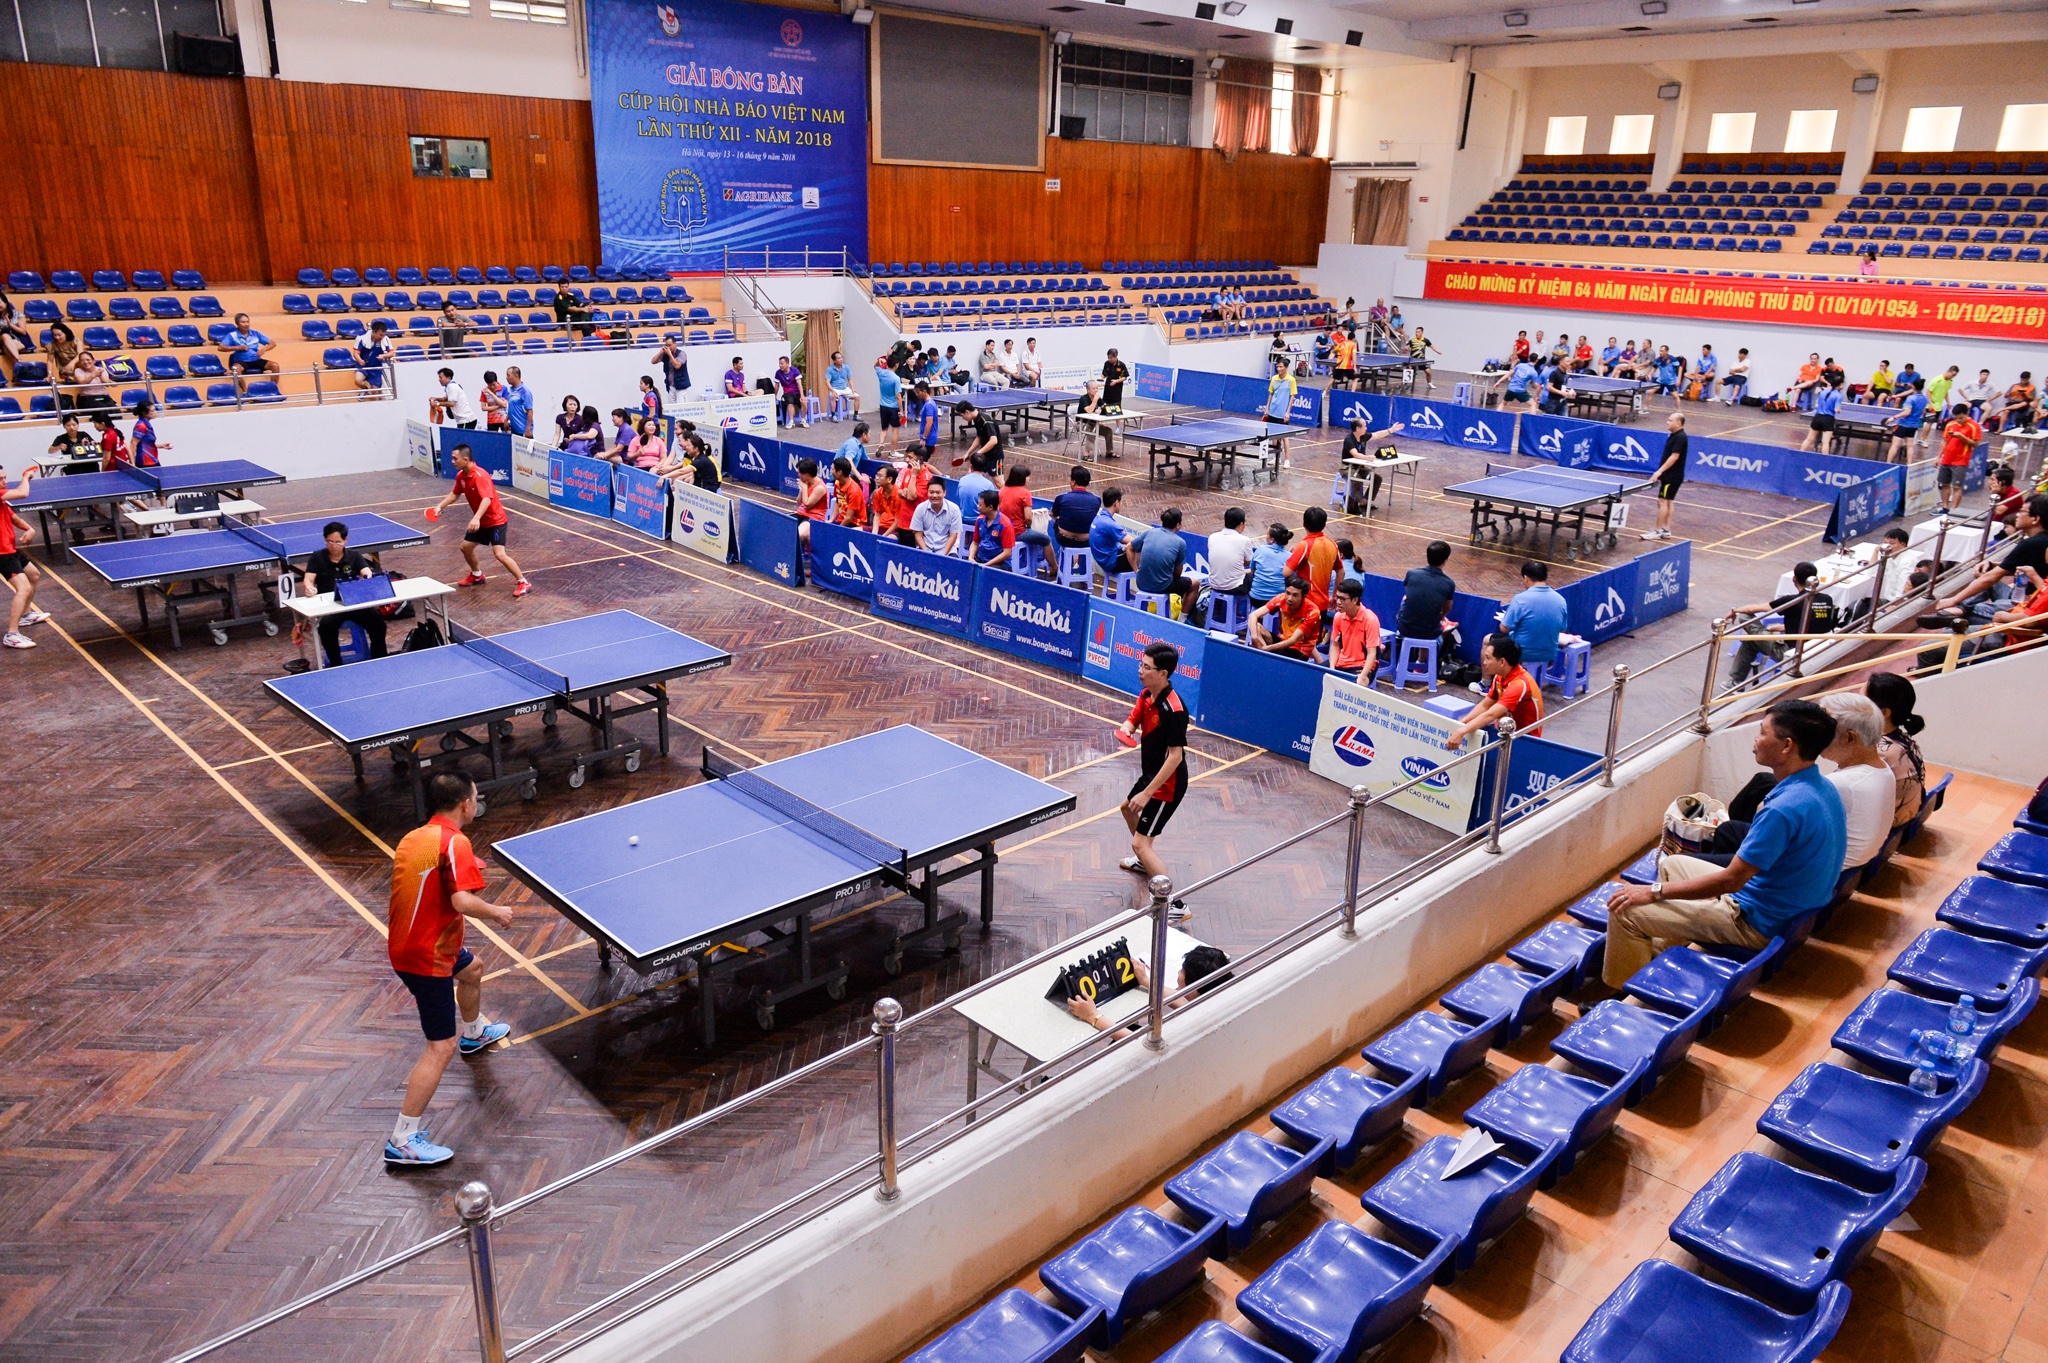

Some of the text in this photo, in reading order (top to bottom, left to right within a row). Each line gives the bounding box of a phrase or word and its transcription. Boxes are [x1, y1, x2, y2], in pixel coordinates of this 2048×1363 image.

[666, 62, 803, 95] GIẢI BÓNG BÀN
[618, 90, 846, 124] CÚP HỘI NHÀ BÁO VIỆT NAM
[637, 116, 672, 138] LẦN
[676, 120, 716, 140] THỨ
[719, 125, 741, 141] XII
[755, 126, 791, 145] NĂM
[795, 130, 832, 146] 2018
[681, 148, 691, 156] Hà
[723, 150, 731, 158] 13
[736, 151, 744, 159] 16
[762, 152, 766, 160] 9
[781, 153, 796, 161] 2018
[734, 191, 793, 202] AGRIBANK
[1445, 274, 1477, 291] CHÀO
[1479, 275, 1516, 293] MỪNG
[1518, 272, 1537, 295] KỶ
[1538, 277, 1572, 299] NIỆM
[1574, 282, 1591, 298] 64
[1594, 280, 1625, 300] NĂM
[1629, 282, 1667, 303] NGÀY
[1669, 281, 1700, 305] GIẢI
[1704, 287, 1754, 309] PHÓNG
[1759, 286, 1789, 311] THỦ
[1792, 291, 1815, 312] ĐÔ
[1818, 296, 1918, 319] (10/10/1954
[1936, 302, 2046, 328] 10/10/2018)
[1404, 371, 1411, 381] 3
[1411, 422, 1444, 431] MOFIT
[1463, 436, 1497, 445] MOFIT
[1607, 453, 1649, 463] MOFIT
[1695, 452, 1763, 473] XIOM
[739, 462, 766, 474] MOFIT
[1611, 506, 1625, 525] 4
[393, 540, 424, 549] CHAMPION
[121, 578, 160, 588] CHAMPION
[832, 569, 874, 584] MOFIT
[885, 560, 960, 601] Nittaku
[281, 576, 293, 600] 9
[908, 603, 962, 624] www.bongban.asia
[990, 587, 1071, 634] Nittaku
[1594, 612, 1624, 631] MOFIT
[1016, 634, 1073, 658] www.bongban.asia
[1114, 642, 1134, 659] PHÂN
[1133, 630, 1151, 646] TỔNG
[1176, 645, 1185, 658] TY
[689, 661, 724, 673] CHAMPION
[1180, 664, 1201, 680] CHẤT
[515, 704, 537, 715] PRO 9
[1333, 700, 1348, 712] TRANH
[1378, 706, 1390, 717] SINH
[1394, 712, 1407, 723] SINH
[1407, 717, 1419, 728] VIÊN
[360, 735, 409, 751] CHAMPION
[1338, 726, 1375, 759] LILAMA
[1409, 788, 1450, 810] CAO VIỆT NAM
[1030, 806, 1068, 824] CHAMPION
[835, 884, 861, 900] PRO 9
[605, 940, 628, 964] XIOM
[652, 939, 711, 967] CHAMPION
[1079, 957, 1134, 1000] 0 0 1 2
